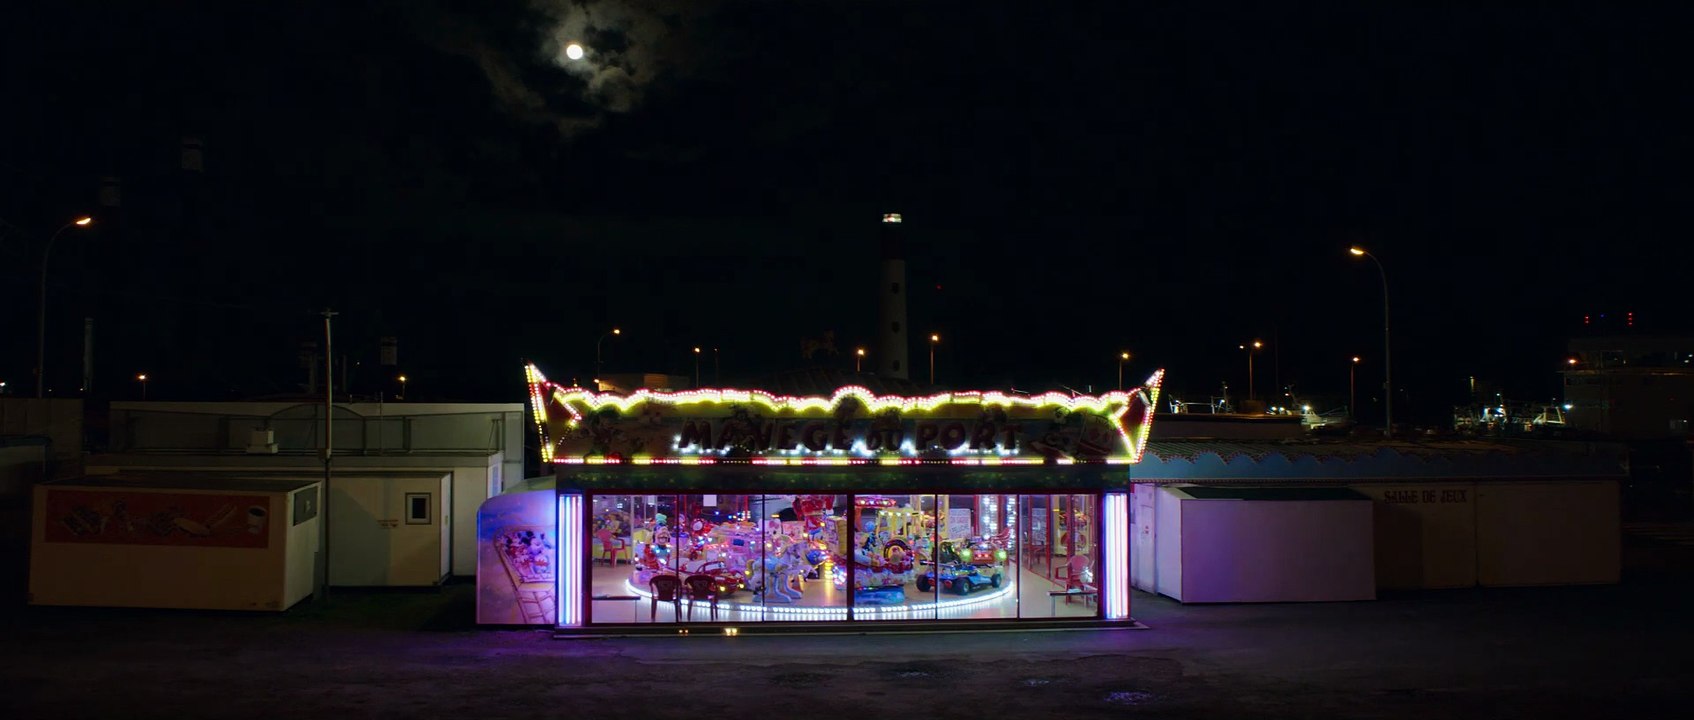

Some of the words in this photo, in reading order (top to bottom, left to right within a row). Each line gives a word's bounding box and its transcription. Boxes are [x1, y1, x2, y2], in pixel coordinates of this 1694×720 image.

[915, 422, 1020, 451] PORT
[1384, 490, 1418, 504] SALLE
[1422, 490, 1436, 504] DE
[1440, 490, 1467, 504] JEUX
